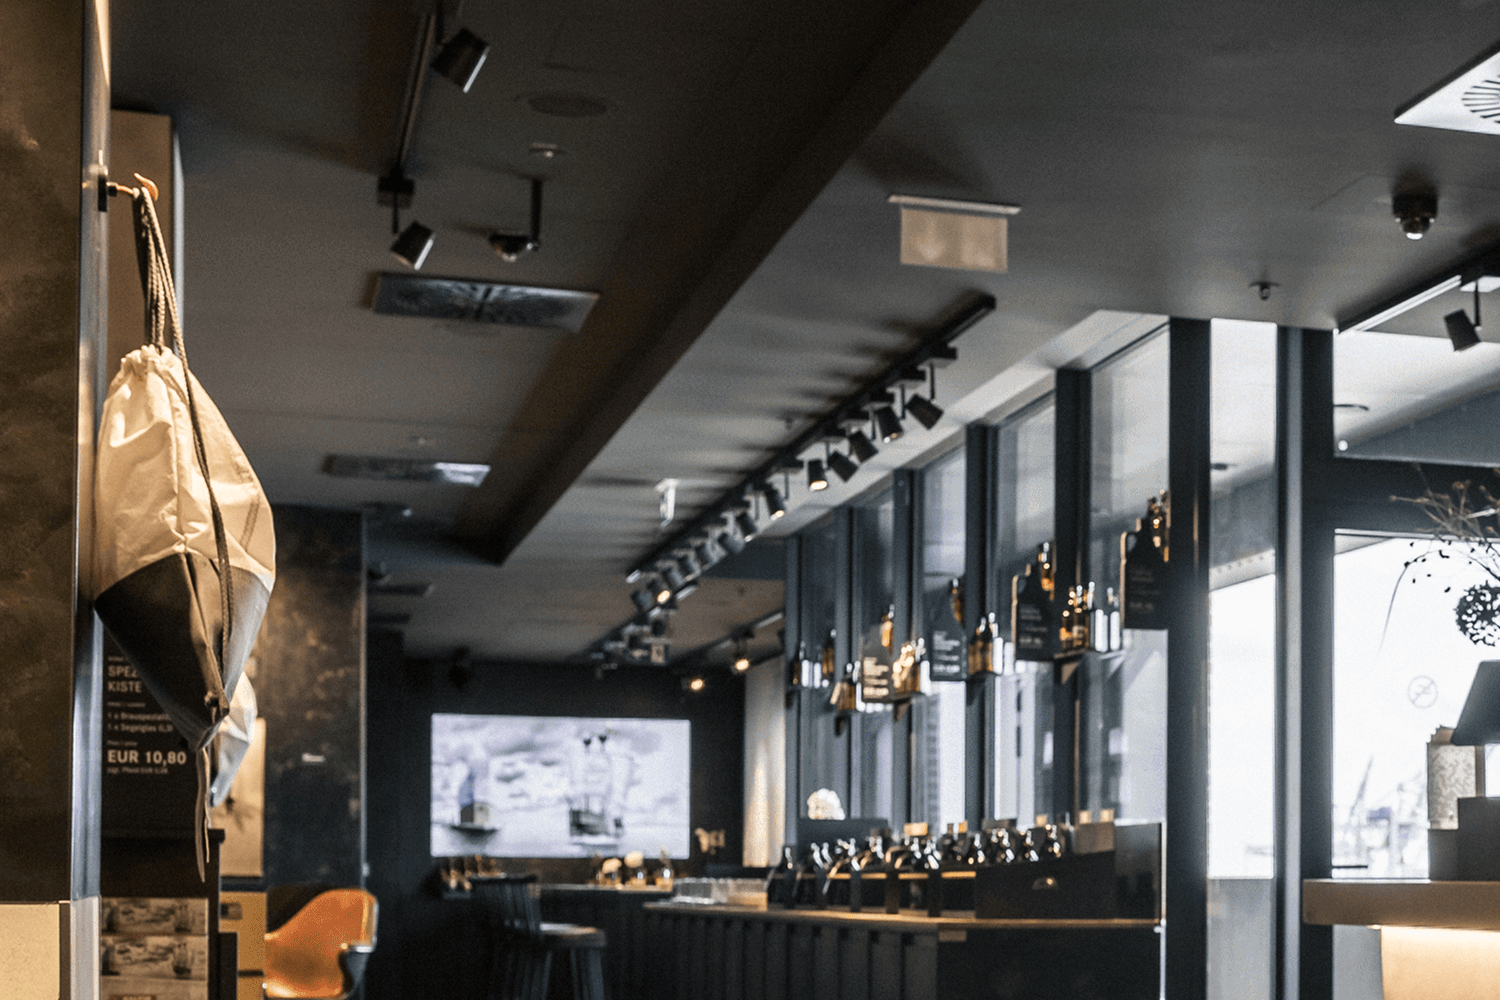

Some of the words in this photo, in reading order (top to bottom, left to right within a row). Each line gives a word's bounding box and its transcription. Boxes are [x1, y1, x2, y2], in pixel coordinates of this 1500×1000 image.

[107, 681, 142, 693] KISTE
[107, 750, 139, 764] EUR
[146, 750, 187, 767] 10,80
